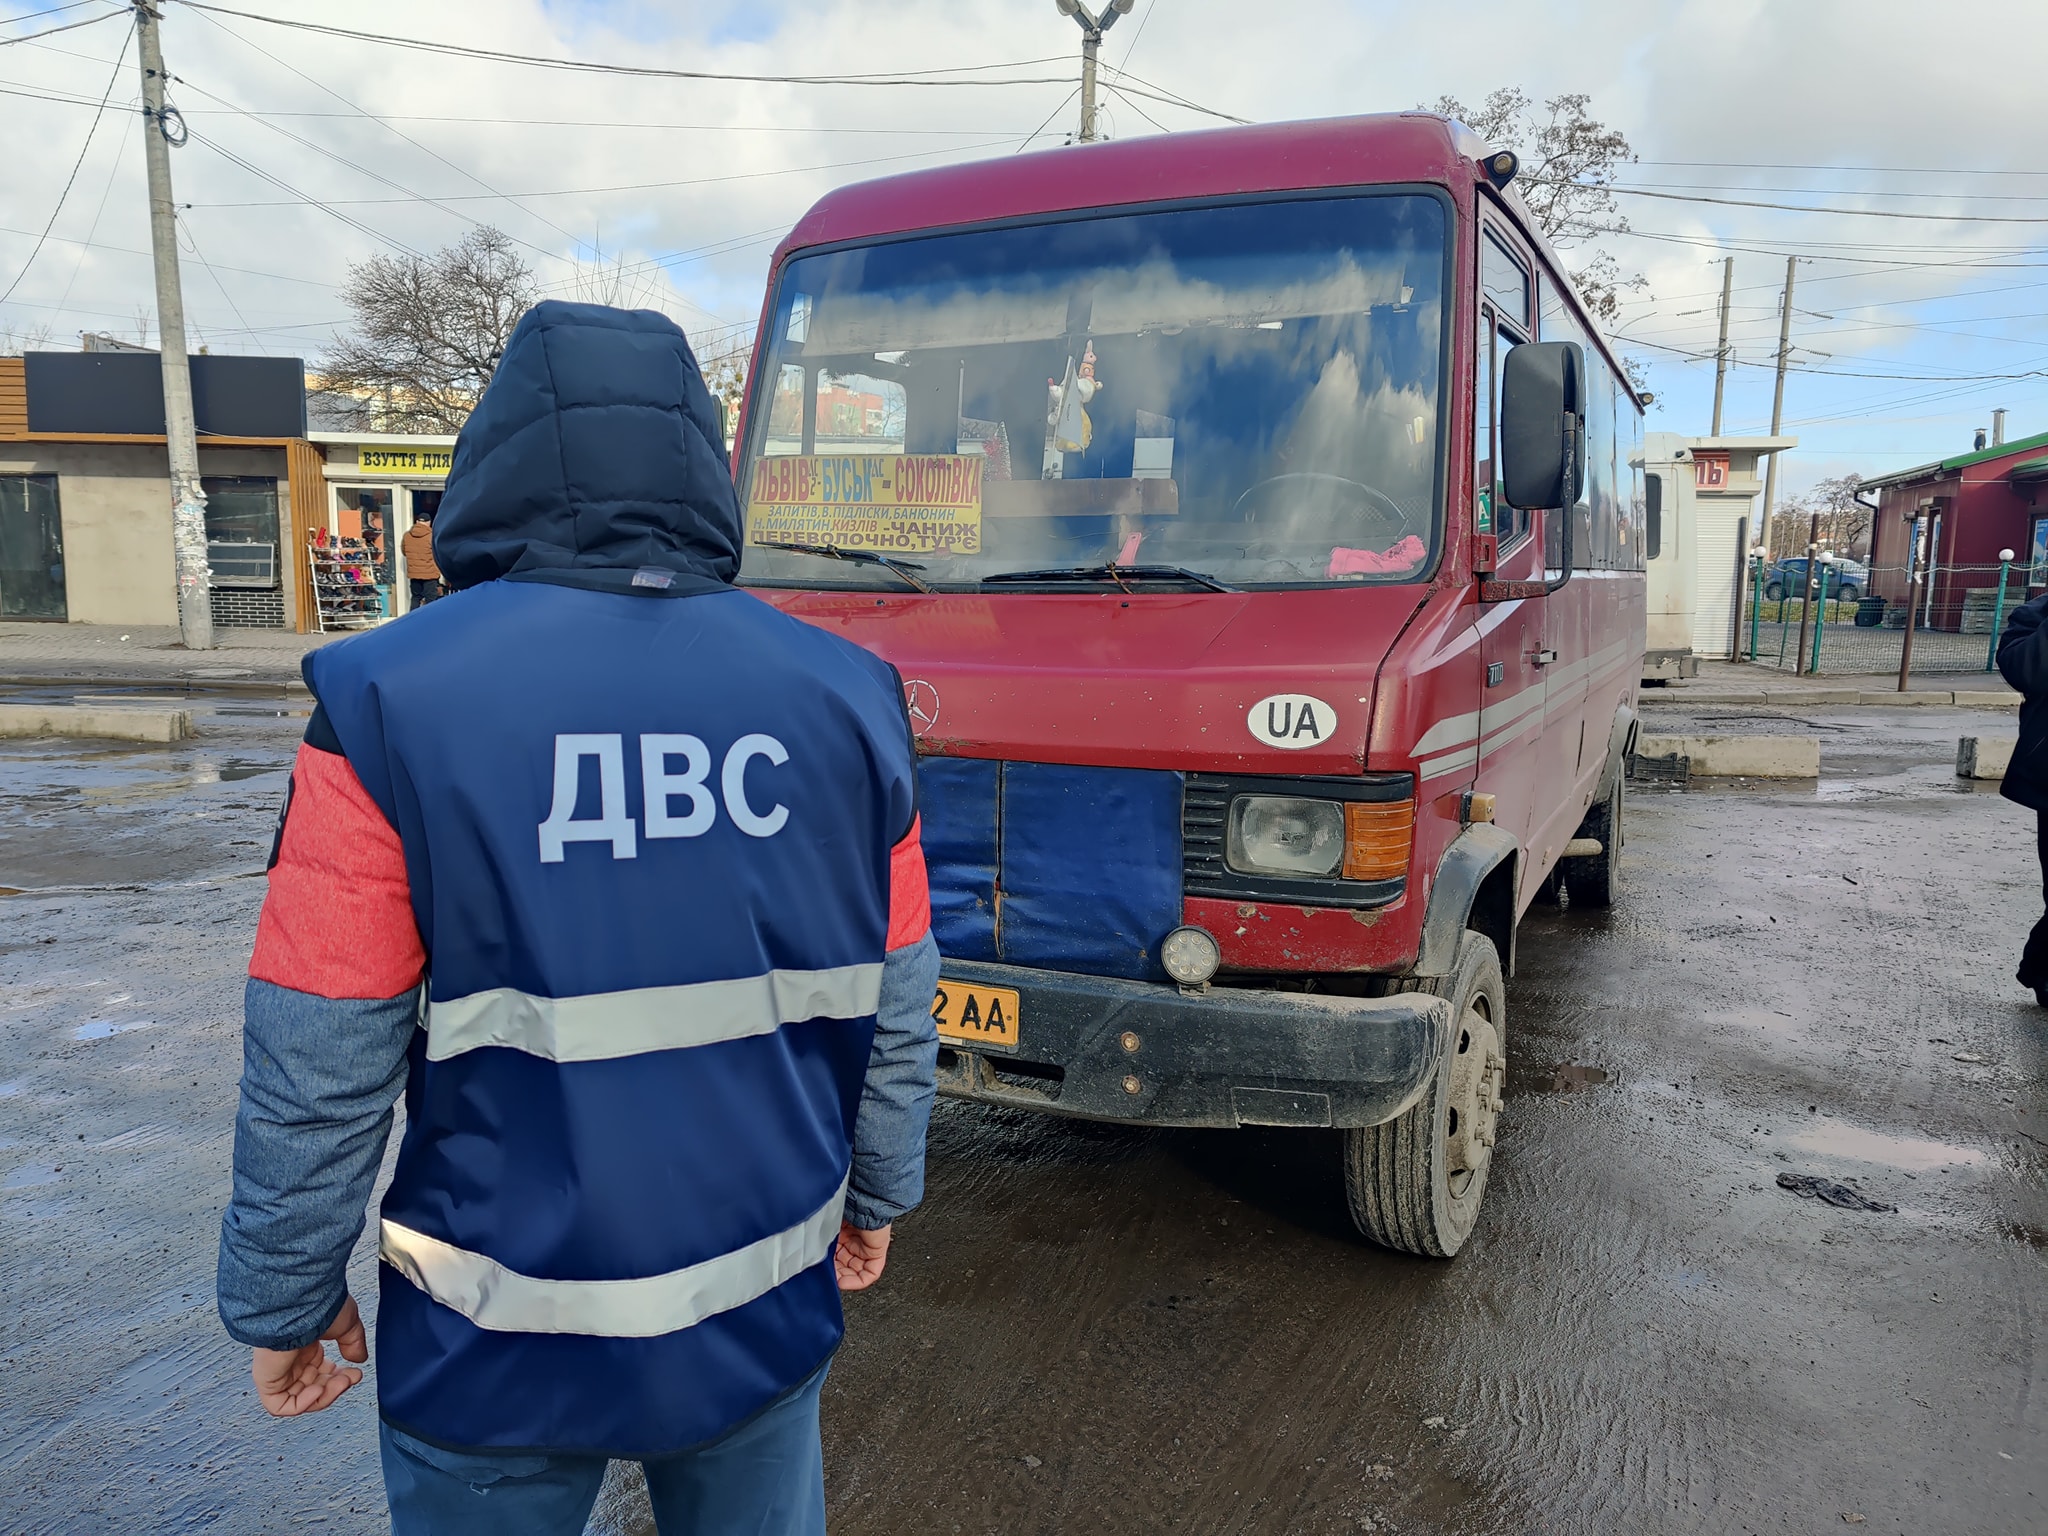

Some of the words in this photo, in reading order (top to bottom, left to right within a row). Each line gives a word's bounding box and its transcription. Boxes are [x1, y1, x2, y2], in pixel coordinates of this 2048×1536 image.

[363, 451, 417, 467] ВЗУТТЯ
[422, 453, 451, 470] ДЛЯ
[752, 458, 810, 502] ЛЬВІВ
[822, 457, 873, 502] БУСЬК
[895, 456, 980, 504] СОКОЛІВКА
[1267, 701, 1321, 741] UA
[538, 733, 791, 864] ДВС
[960, 994, 1007, 1034] AA
